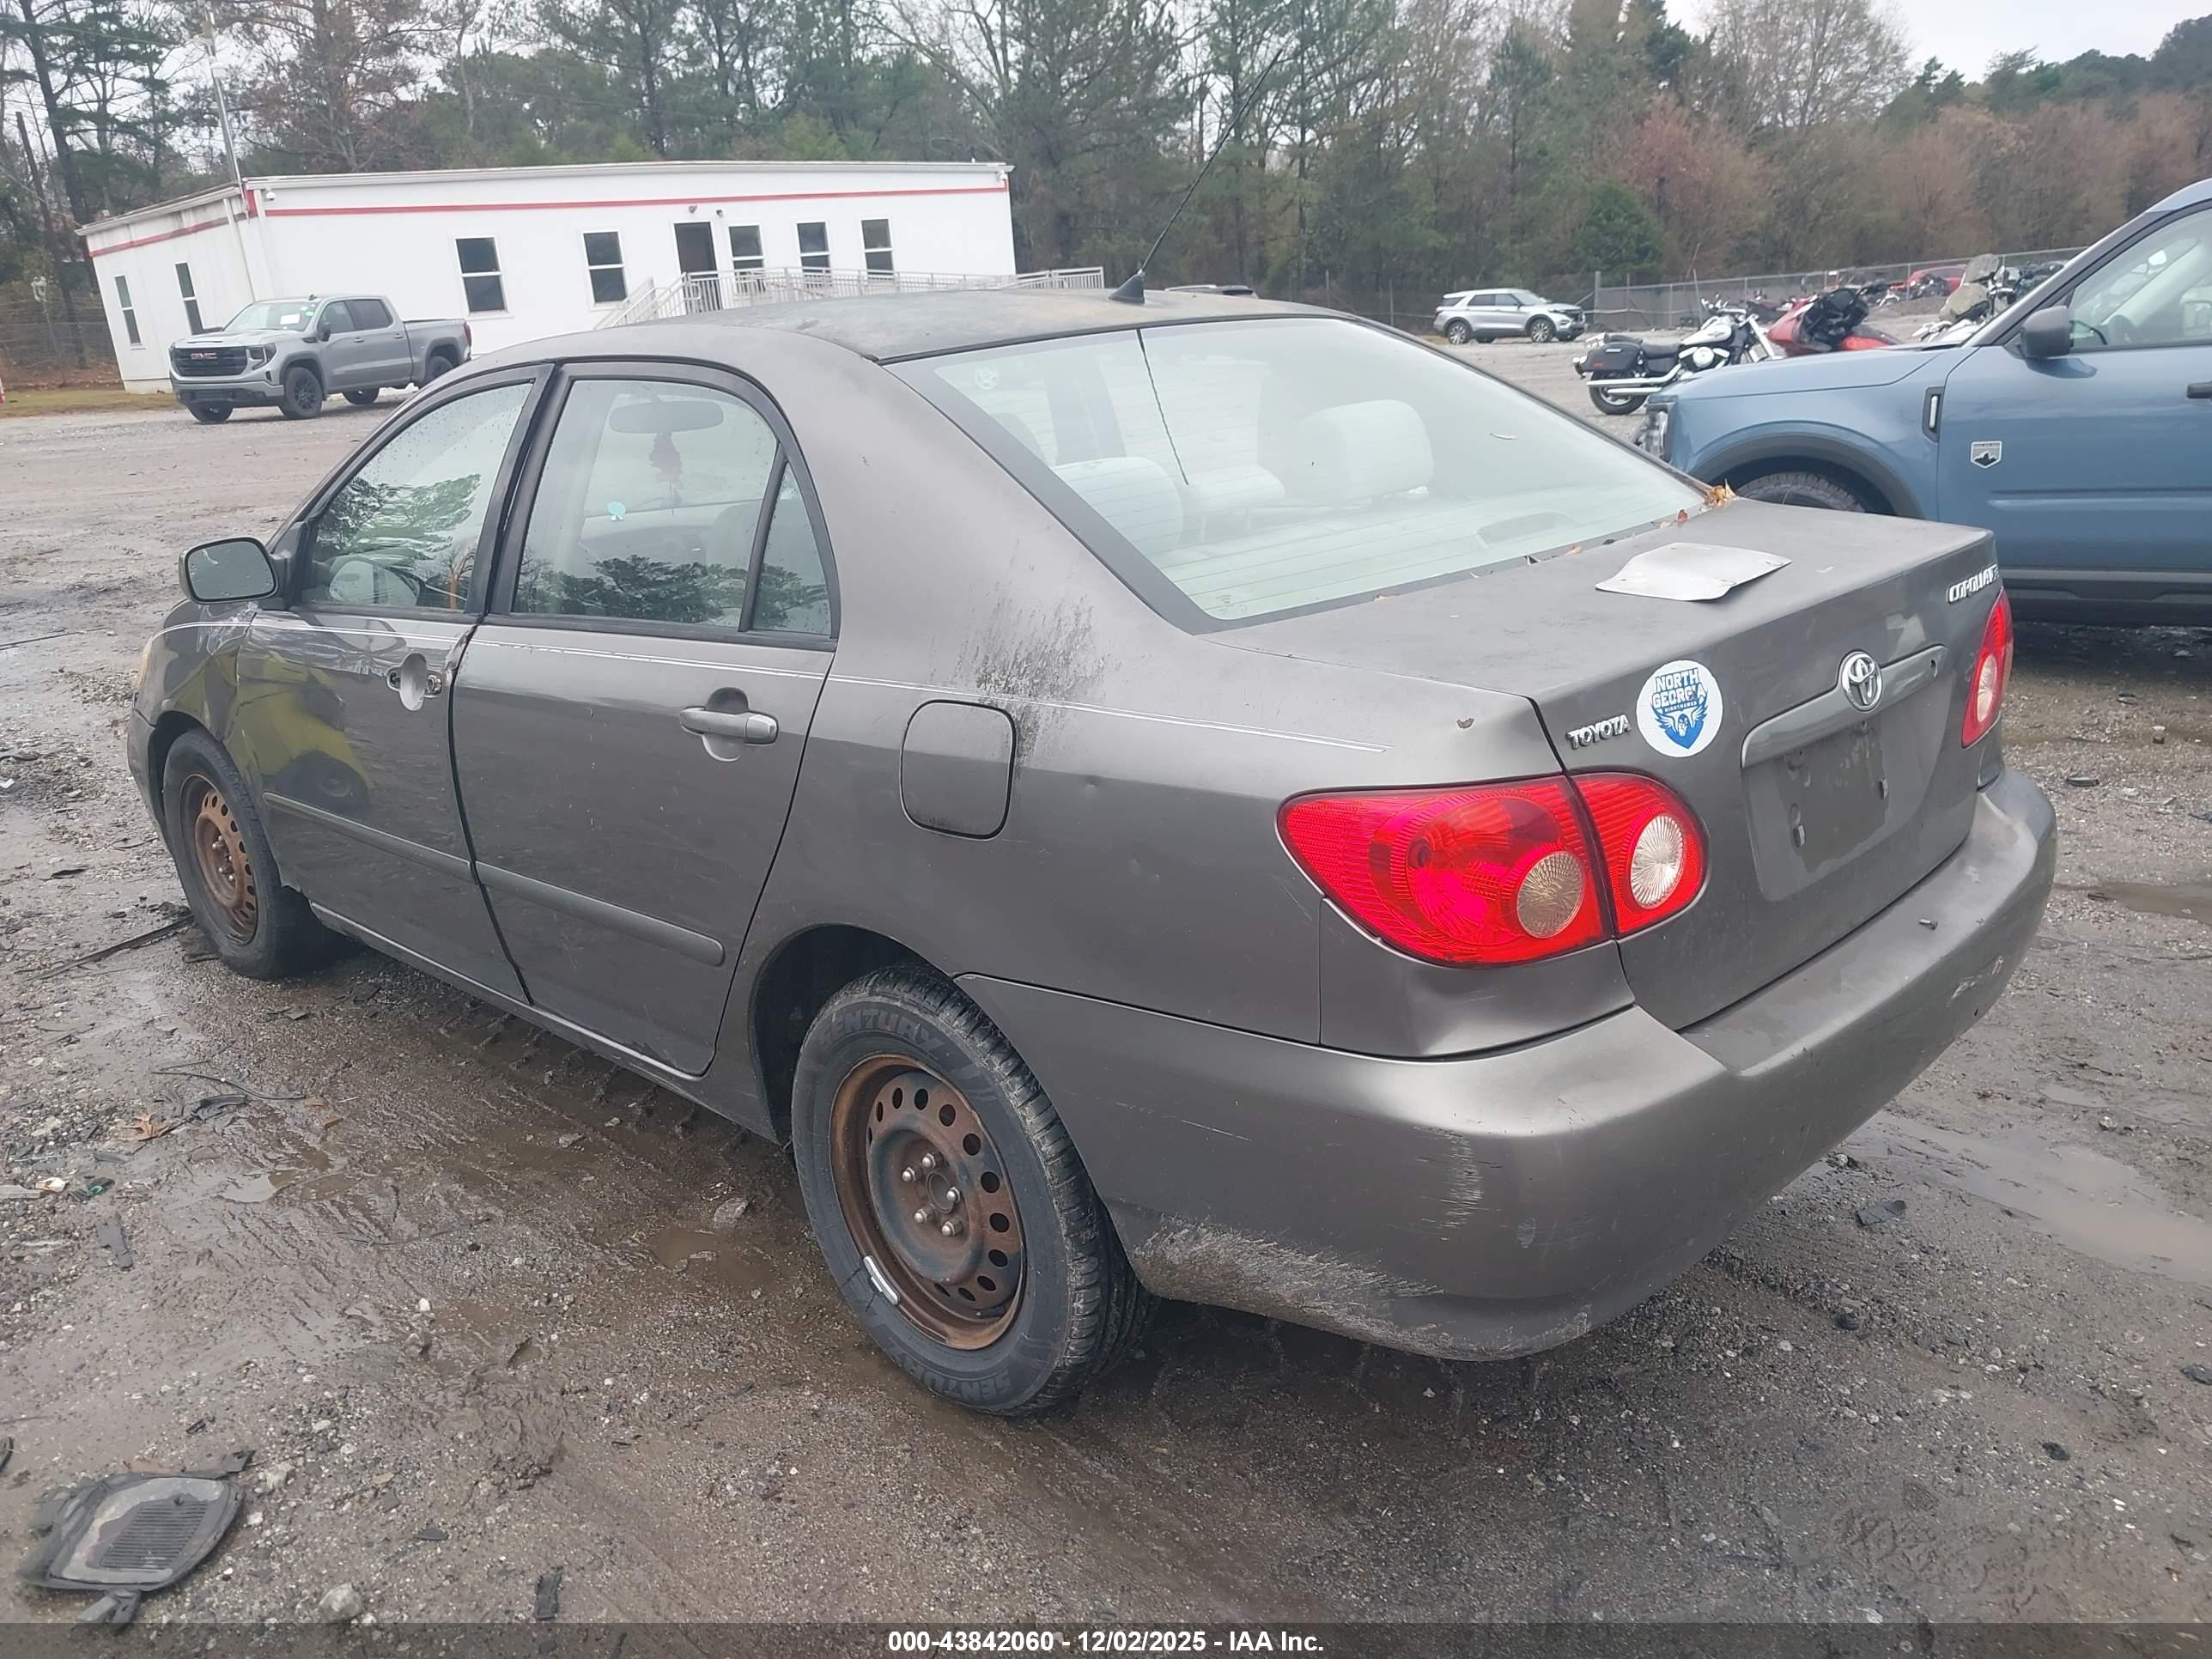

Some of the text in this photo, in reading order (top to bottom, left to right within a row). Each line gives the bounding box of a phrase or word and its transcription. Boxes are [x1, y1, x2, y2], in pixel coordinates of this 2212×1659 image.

[1656, 667, 1699, 694] NORTH
[1651, 682, 1707, 709] GEORGIA
[1566, 714, 1631, 750] TOYOTA
